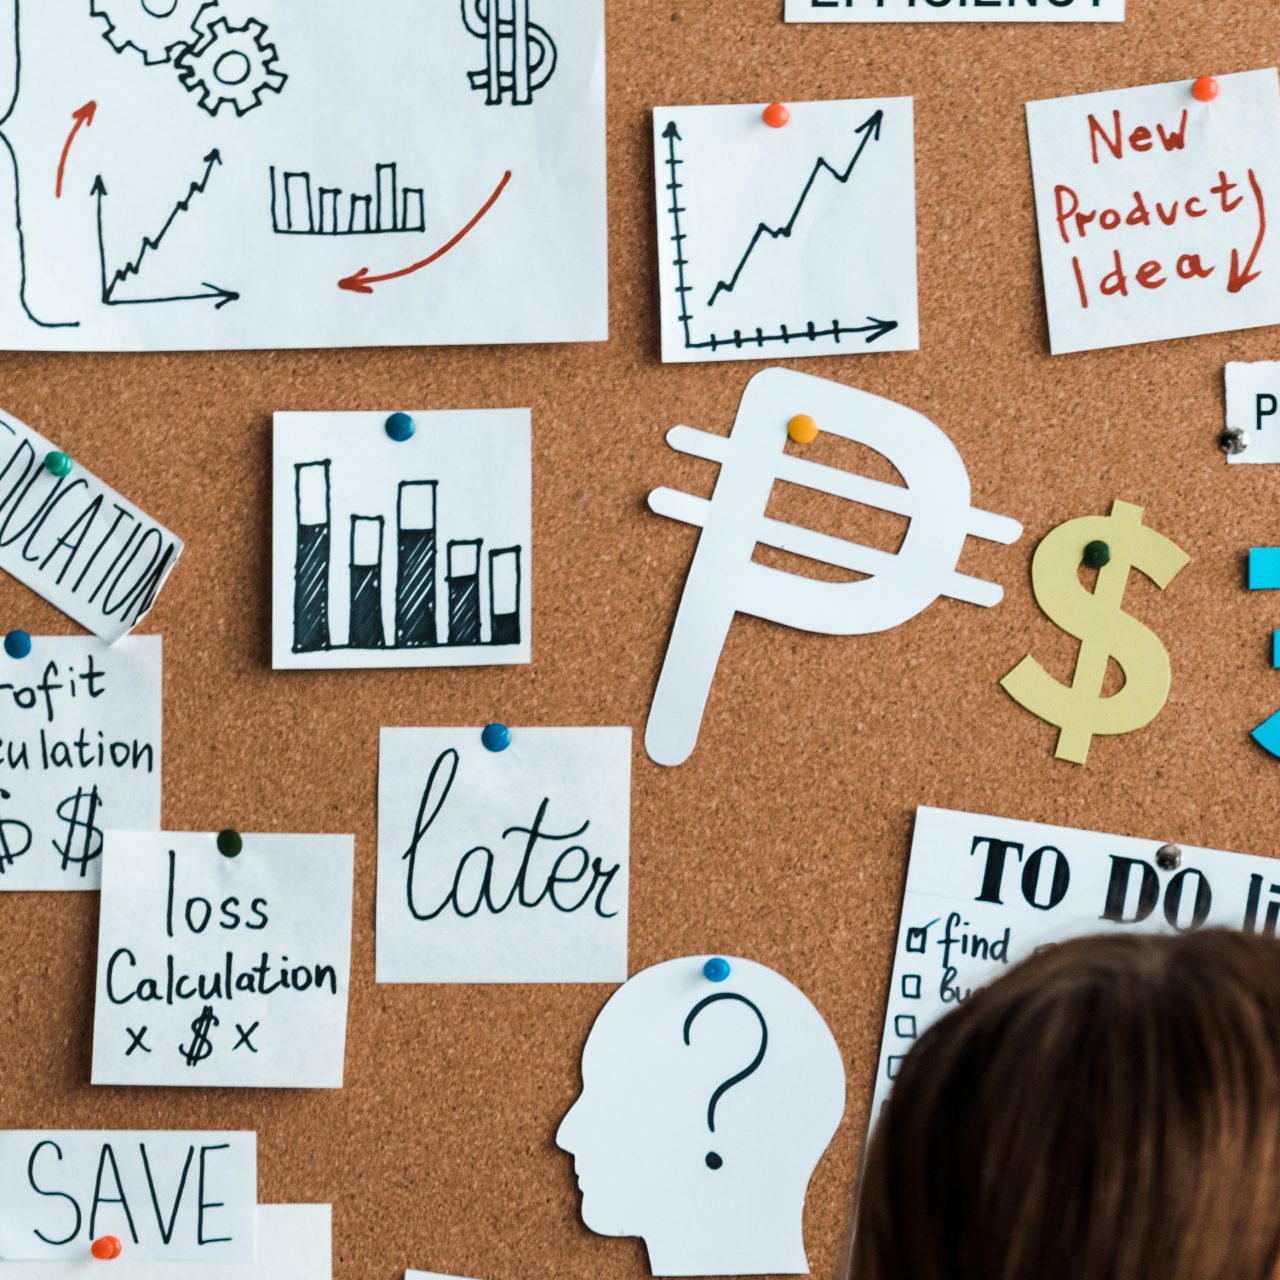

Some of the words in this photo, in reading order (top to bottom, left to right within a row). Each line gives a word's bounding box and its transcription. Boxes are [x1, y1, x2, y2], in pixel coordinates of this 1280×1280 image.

[1088, 109, 1187, 164] New
[1054, 171, 1243, 243] Product
[1072, 250, 1214, 308] Idea
[402, 748, 620, 921] later
[167, 849, 269, 937] loss
[971, 836, 1070, 910] TO
[1098, 854, 1213, 931] DO
[936, 912, 1011, 968] find
[107, 948, 336, 1005] Calculation
[27, 1140, 233, 1246] SAVE
